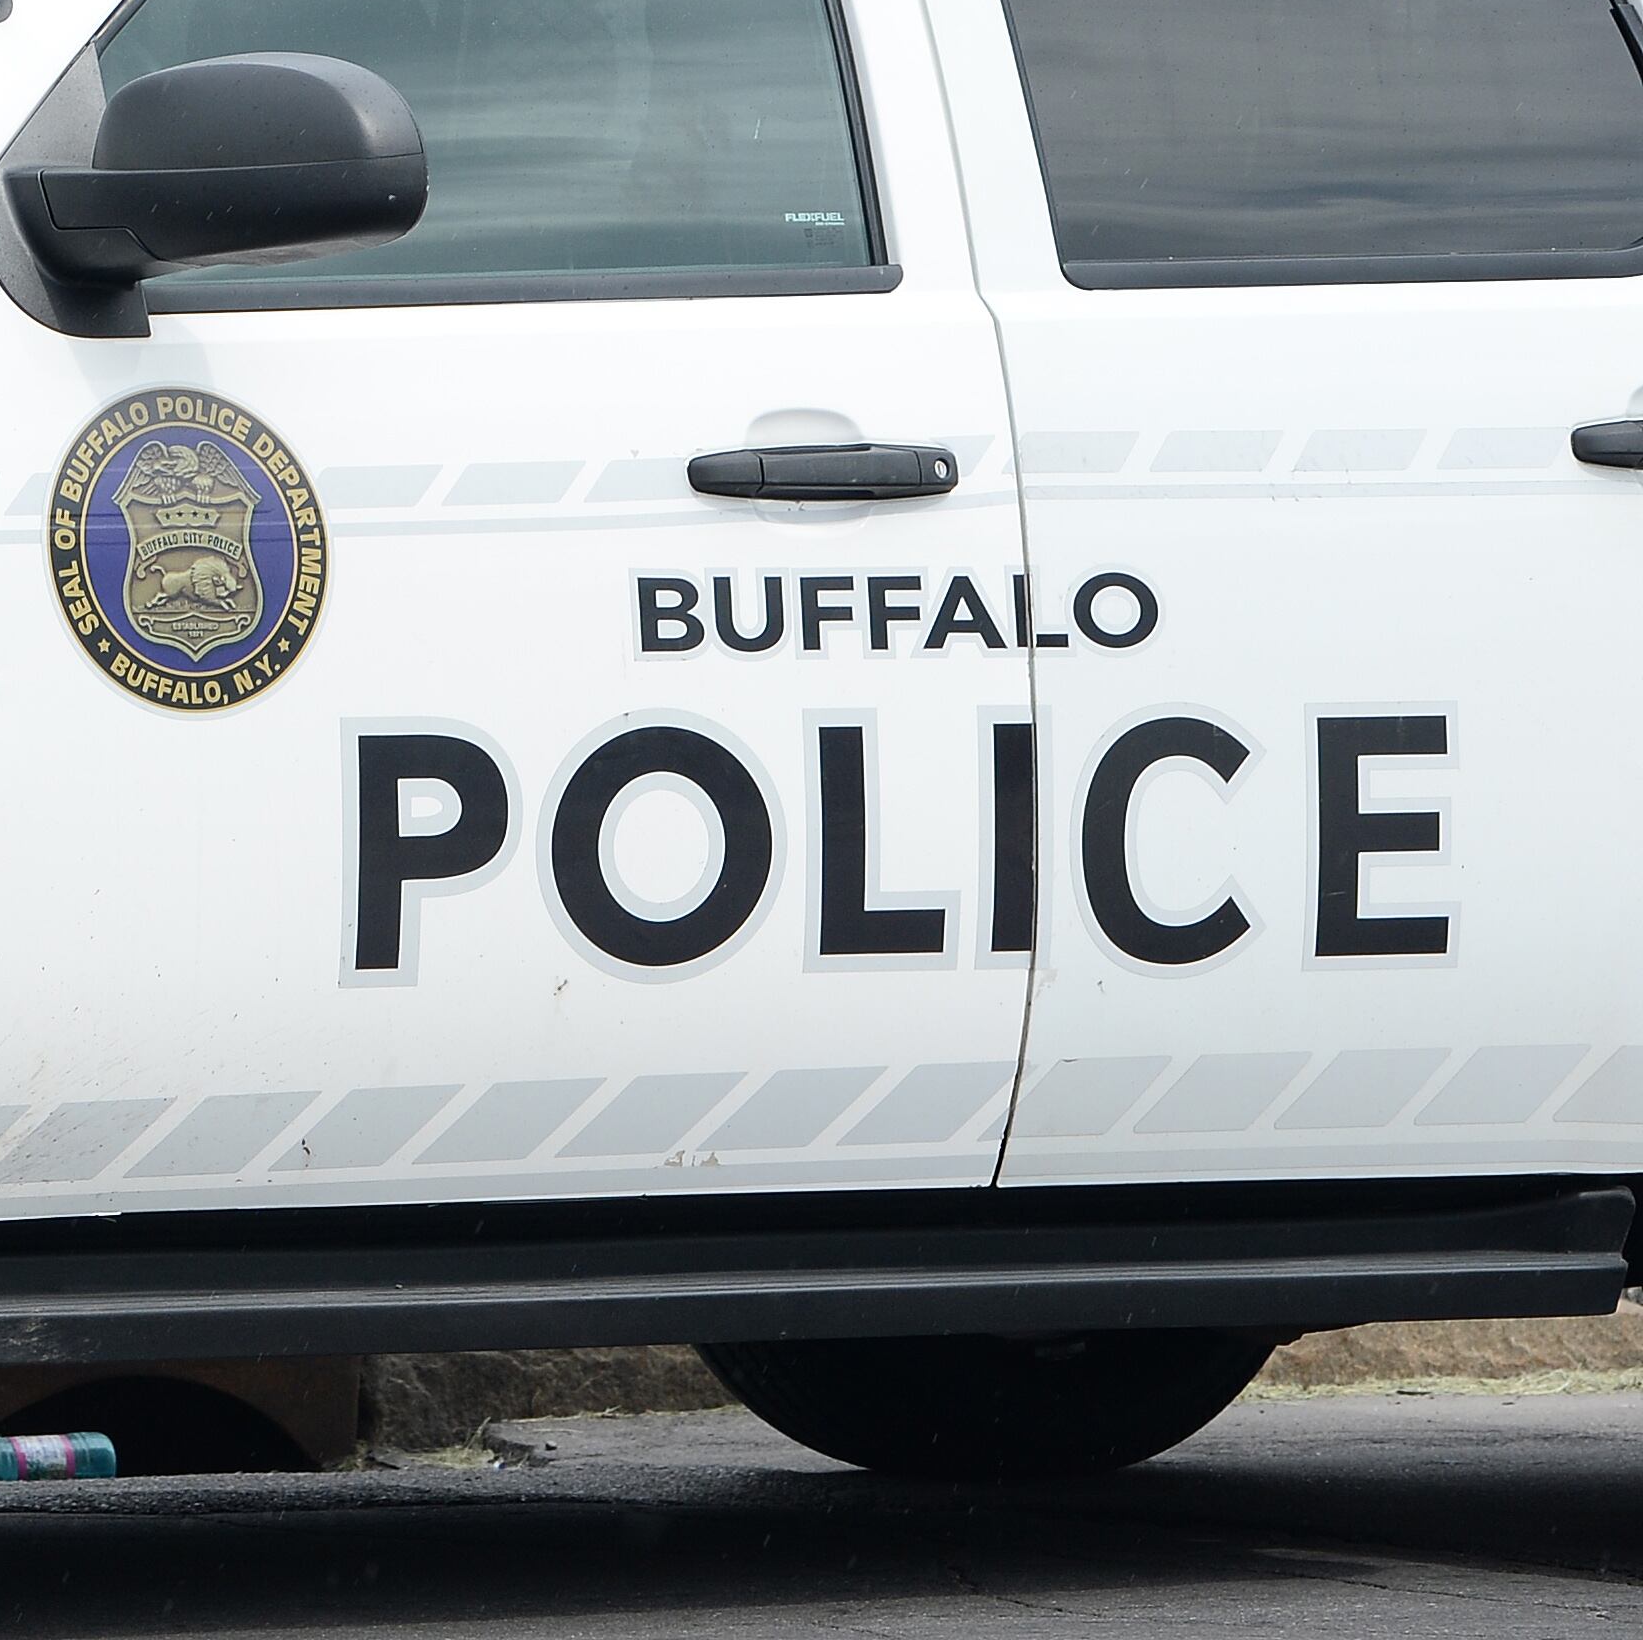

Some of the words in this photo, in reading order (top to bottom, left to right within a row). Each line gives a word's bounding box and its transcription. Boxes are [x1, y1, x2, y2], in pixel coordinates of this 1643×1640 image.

[58, 400, 150, 505] BUFFALO
[156, 394, 252, 441] POLICE
[54, 507, 78, 551] OF
[141, 534, 178, 557] BUFFALO
[183, 532, 204, 544] CITY
[208, 534, 241, 557] POLICE
[252, 431, 324, 637] DEPARTMENT
[58, 559, 101, 636] SEAL
[635, 570, 1160, 655] BUFFALO
[109, 654, 230, 706] BUFFALO,
[353, 713, 1452, 972] POLICE
